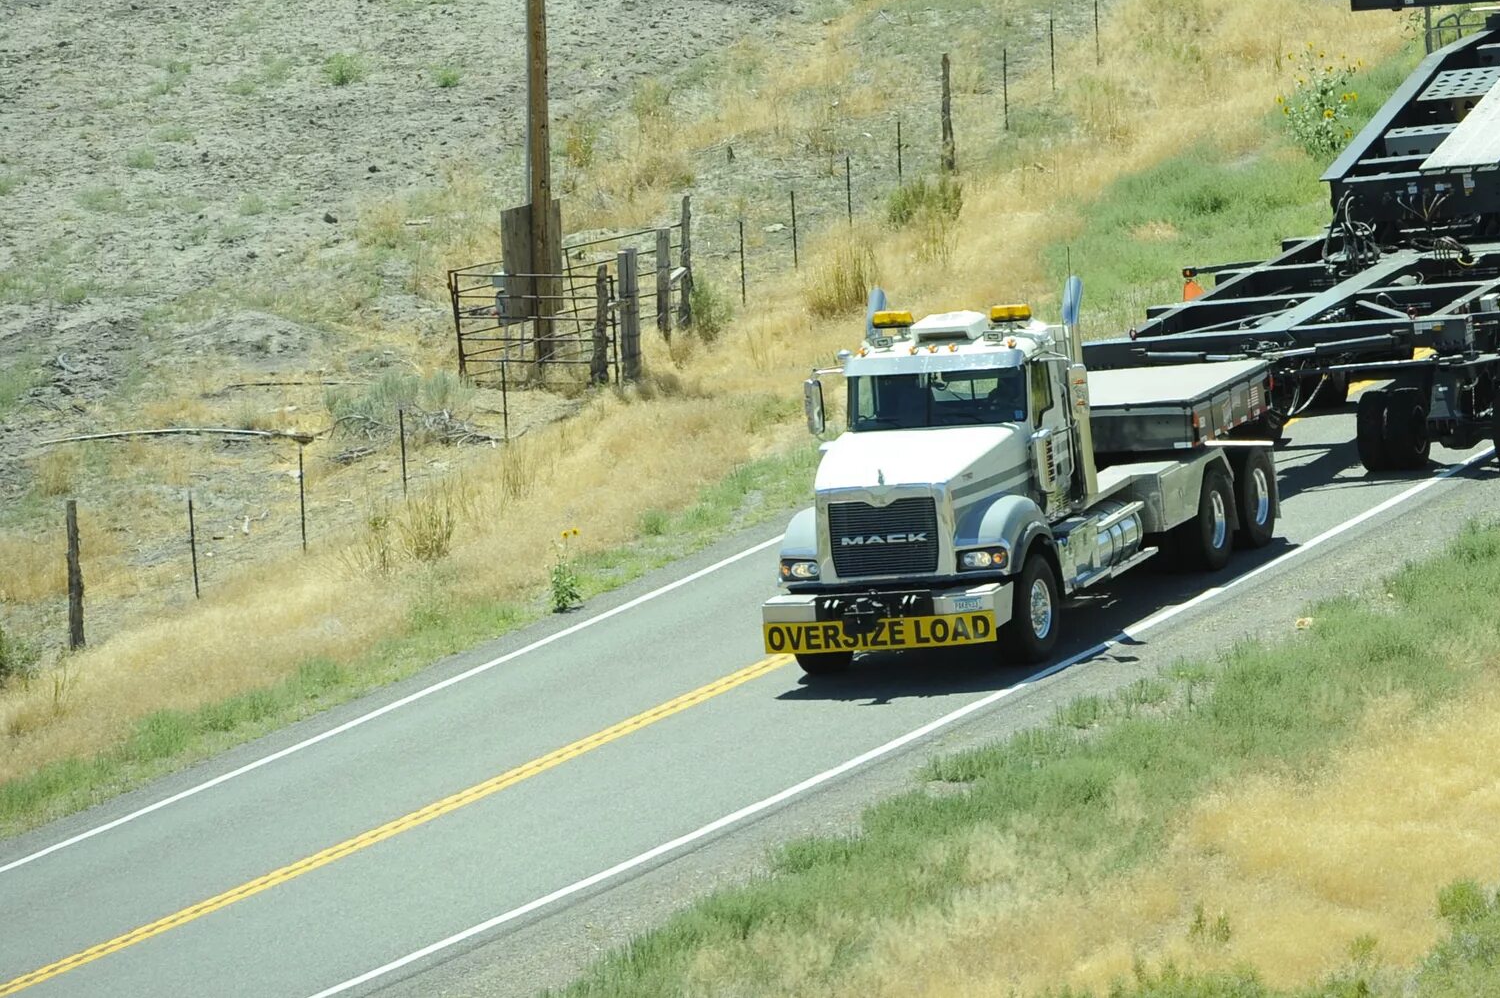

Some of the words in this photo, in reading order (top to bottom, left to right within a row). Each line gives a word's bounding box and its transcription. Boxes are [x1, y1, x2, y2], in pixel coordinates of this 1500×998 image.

[841, 532, 928, 546] MACK
[767, 620, 906, 652] OVERSIZE
[914, 614, 991, 644] LOAD
